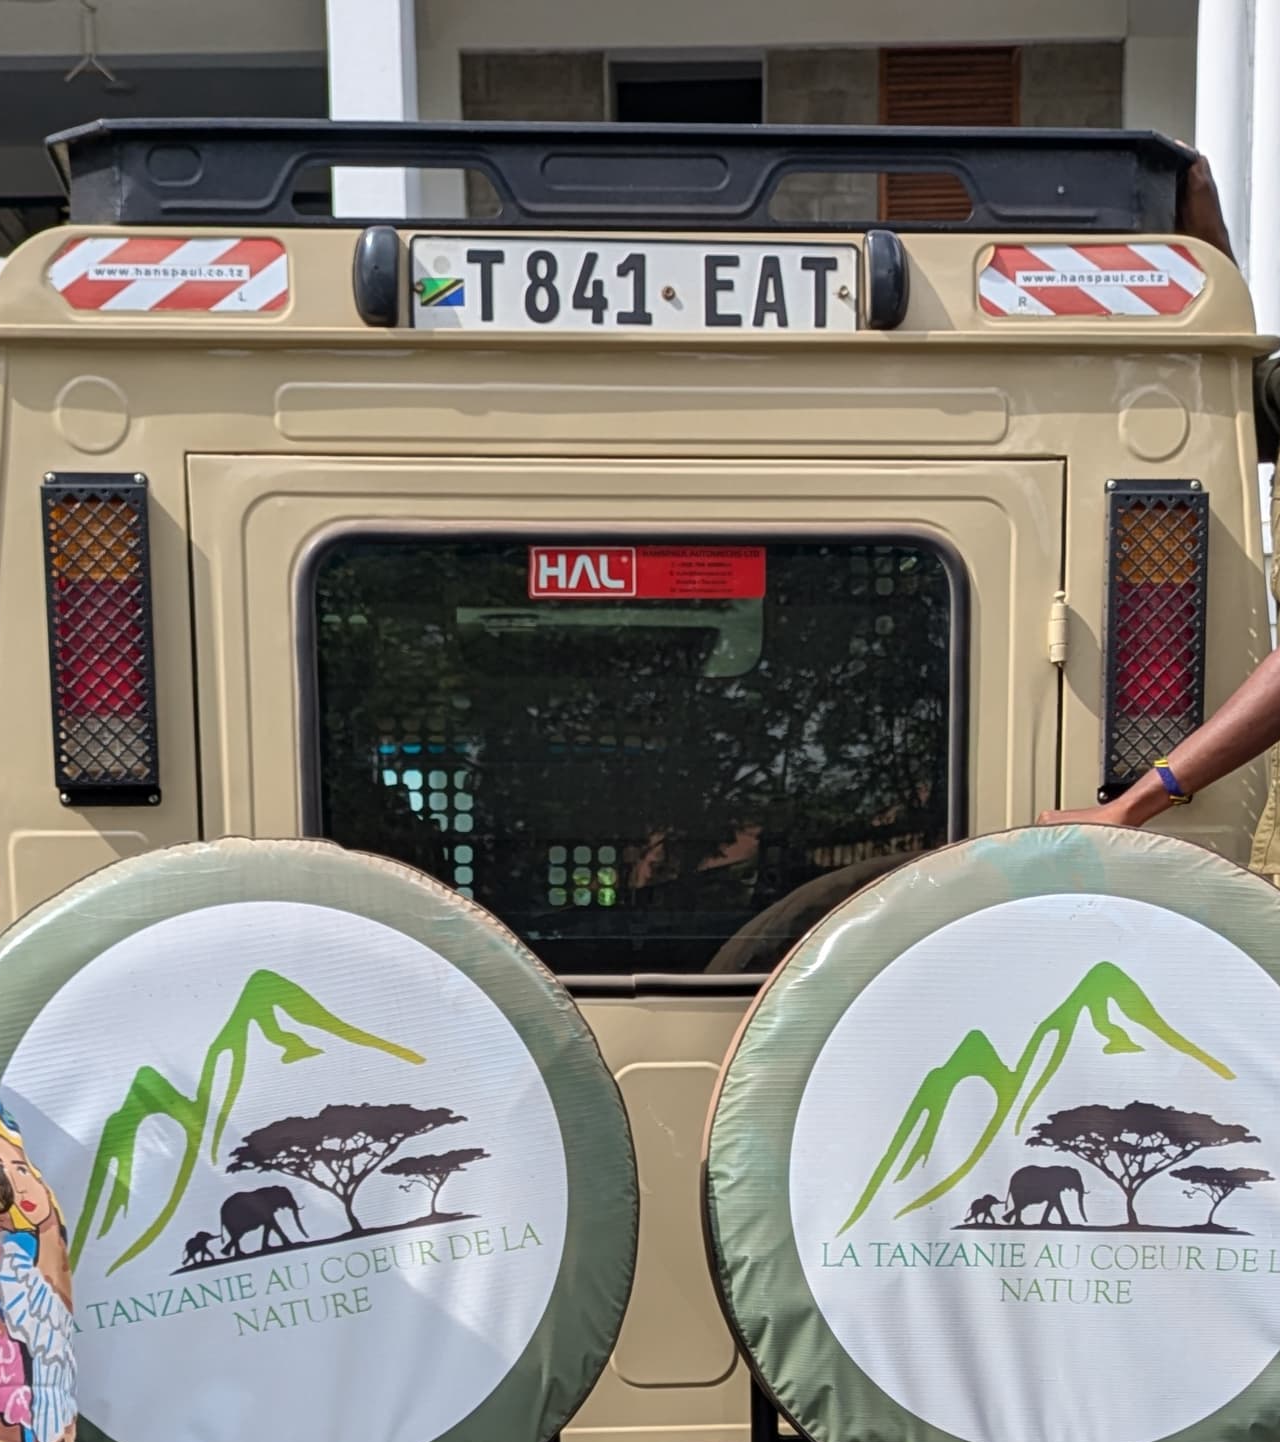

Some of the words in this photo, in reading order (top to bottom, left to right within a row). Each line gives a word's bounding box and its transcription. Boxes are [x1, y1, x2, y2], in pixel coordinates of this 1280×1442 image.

[94, 267, 245, 279] www.hanspaul.co.tz
[1022, 273, 1166, 285] www.hanspaul.co.tz
[704, 255, 838, 328] EAT
[1018, 296, 1028, 307] R
[539, 554, 625, 589] HAL
[821, 1242, 861, 1268] LA
[869, 1242, 1026, 1269] TANZANIE
[1033, 1243, 1080, 1271] AU
[1089, 1243, 1204, 1271] COEUR
[1215, 1247, 1259, 1273] DE
[86, 1273, 256, 1329] TANZANIE
[265, 1263, 310, 1296] AU
[320, 1240, 437, 1285] COEUR
[448, 1231, 495, 1265] DE
[503, 1222, 544, 1252] LA
[1000, 1278, 1133, 1305] NATURE
[233, 1286, 373, 1337] NATURE
